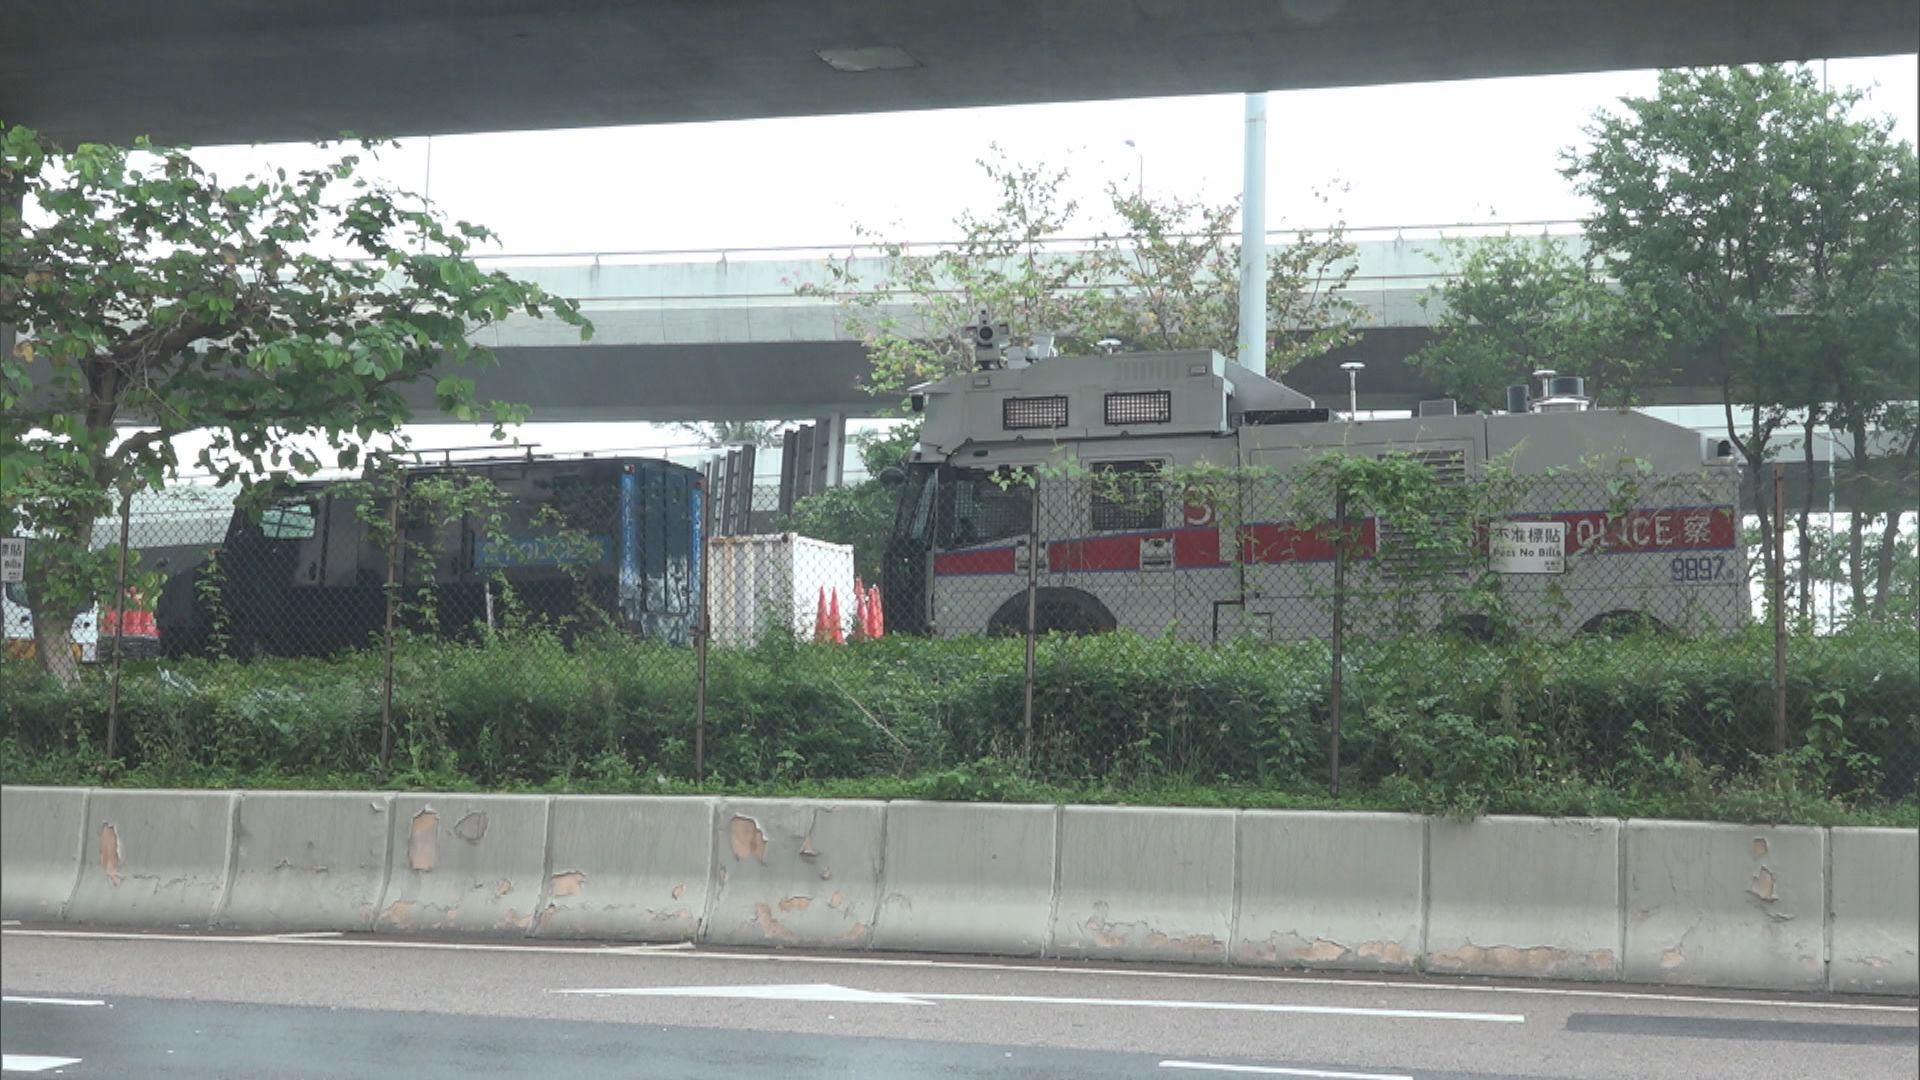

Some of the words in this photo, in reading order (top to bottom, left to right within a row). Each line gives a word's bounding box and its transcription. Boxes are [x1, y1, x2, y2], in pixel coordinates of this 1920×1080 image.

[1566, 515, 1673, 547] OLICE
[1683, 514, 1712, 544] 察
[1519, 547, 1535, 558] No
[1538, 547, 1562, 558] Bills
[1672, 555, 1725, 582] 9897
